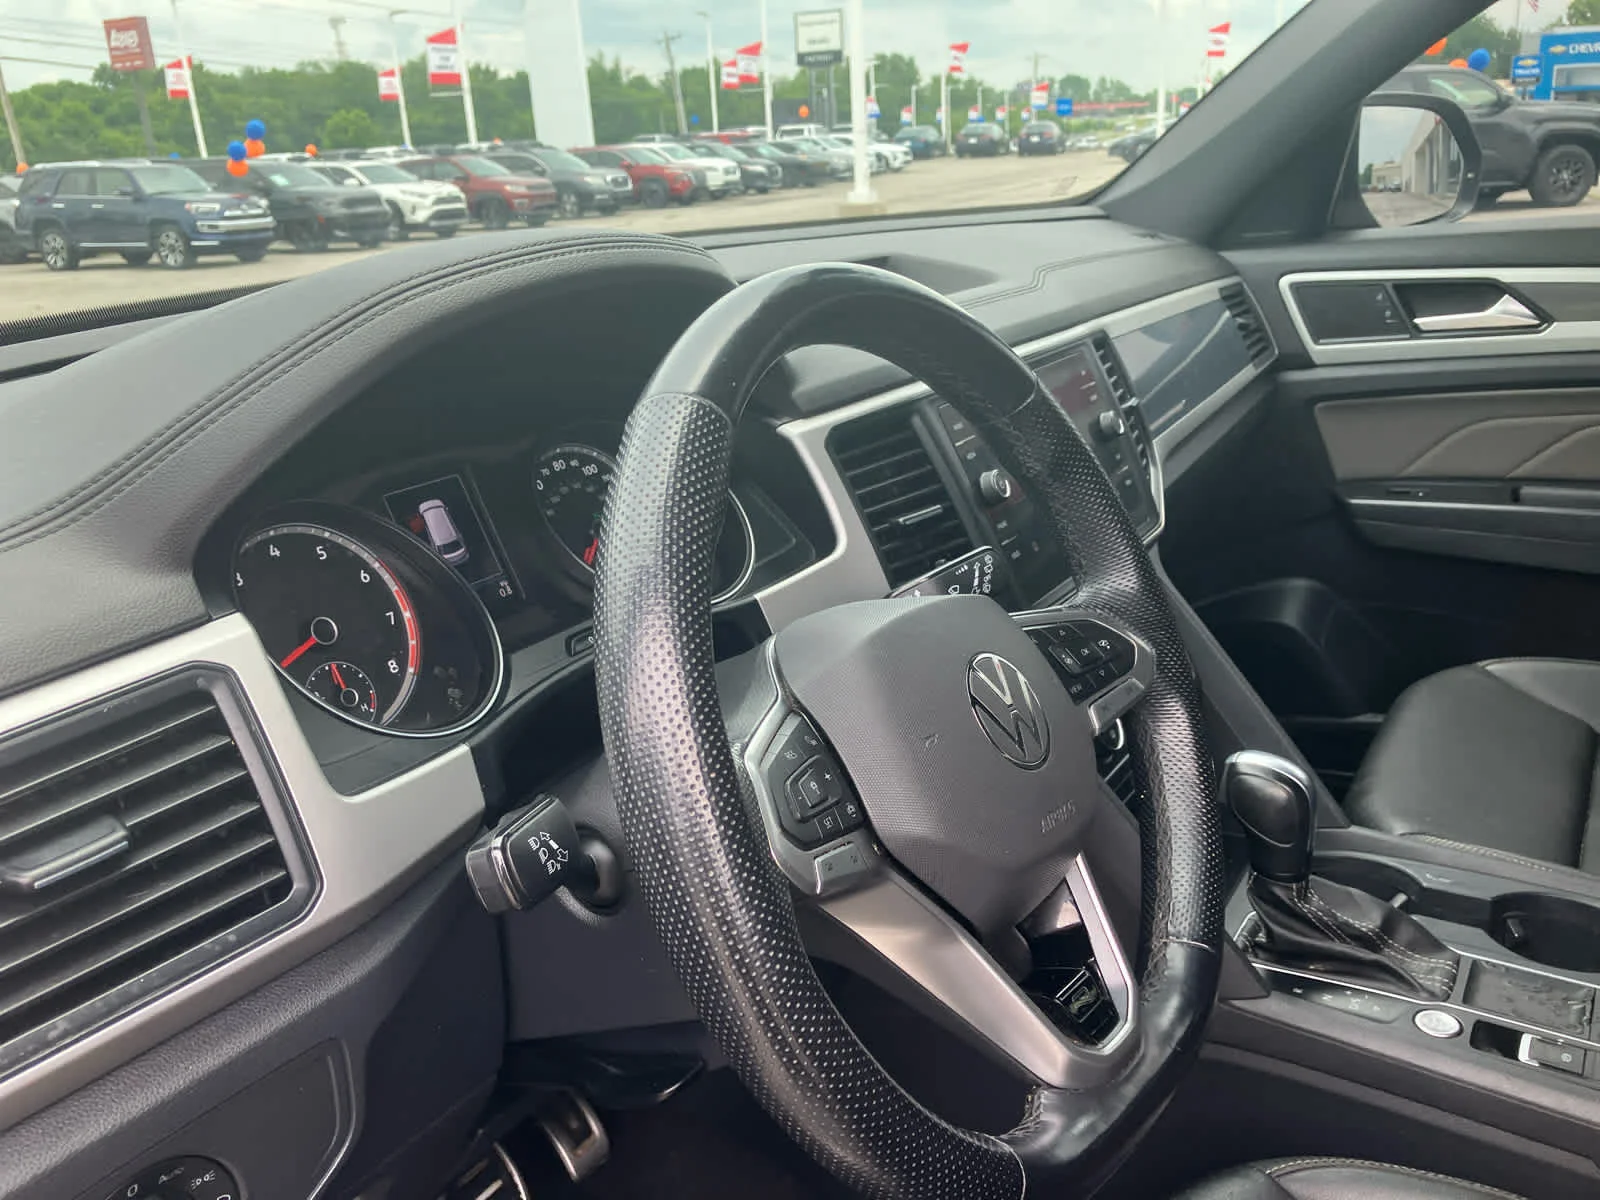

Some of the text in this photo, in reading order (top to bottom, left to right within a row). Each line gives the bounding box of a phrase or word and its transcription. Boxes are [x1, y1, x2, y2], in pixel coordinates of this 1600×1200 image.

[552, 459, 566, 472] 80
[581, 463, 598, 476] 100
[269, 544, 281, 557] 4
[316, 545, 328, 560] 5
[236, 572, 244, 587] 3
[360, 569, 371, 583] 6
[385, 611, 395, 625] 7
[387, 660, 399, 674] 8
[360, 702, 369, 713] H
